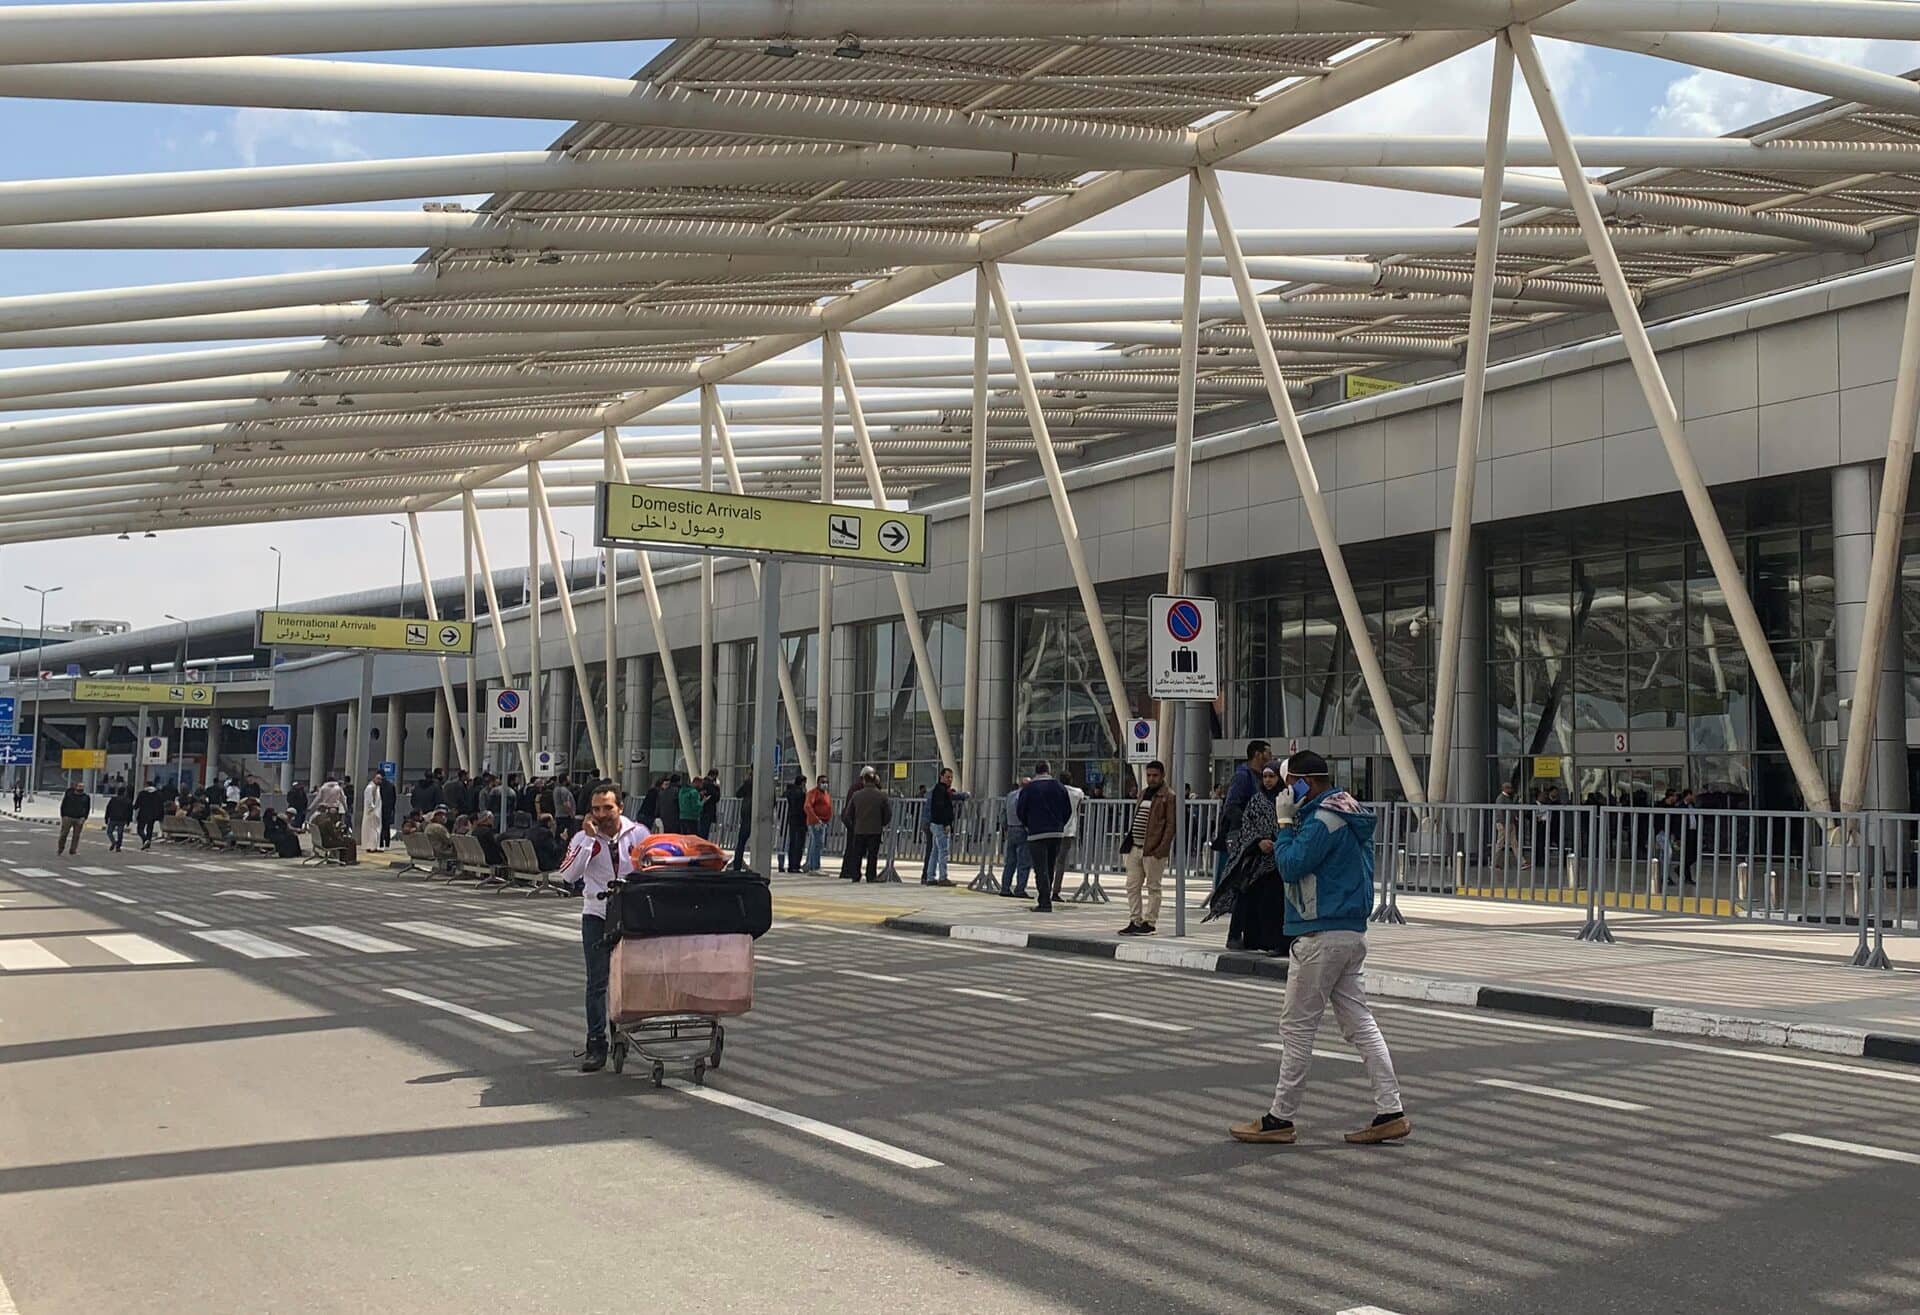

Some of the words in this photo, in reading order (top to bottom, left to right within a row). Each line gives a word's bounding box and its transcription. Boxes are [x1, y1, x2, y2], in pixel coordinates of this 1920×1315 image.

[631, 494, 703, 516] Domestic
[706, 502, 762, 521] Arrivals
[681, 519, 725, 539] وصول
[277, 616, 338, 629] International
[341, 620, 377, 631] Arrivals
[302, 629, 331, 641] وصول
[1290, 739, 1297, 753] 4
[1616, 734, 1625, 751] 3
